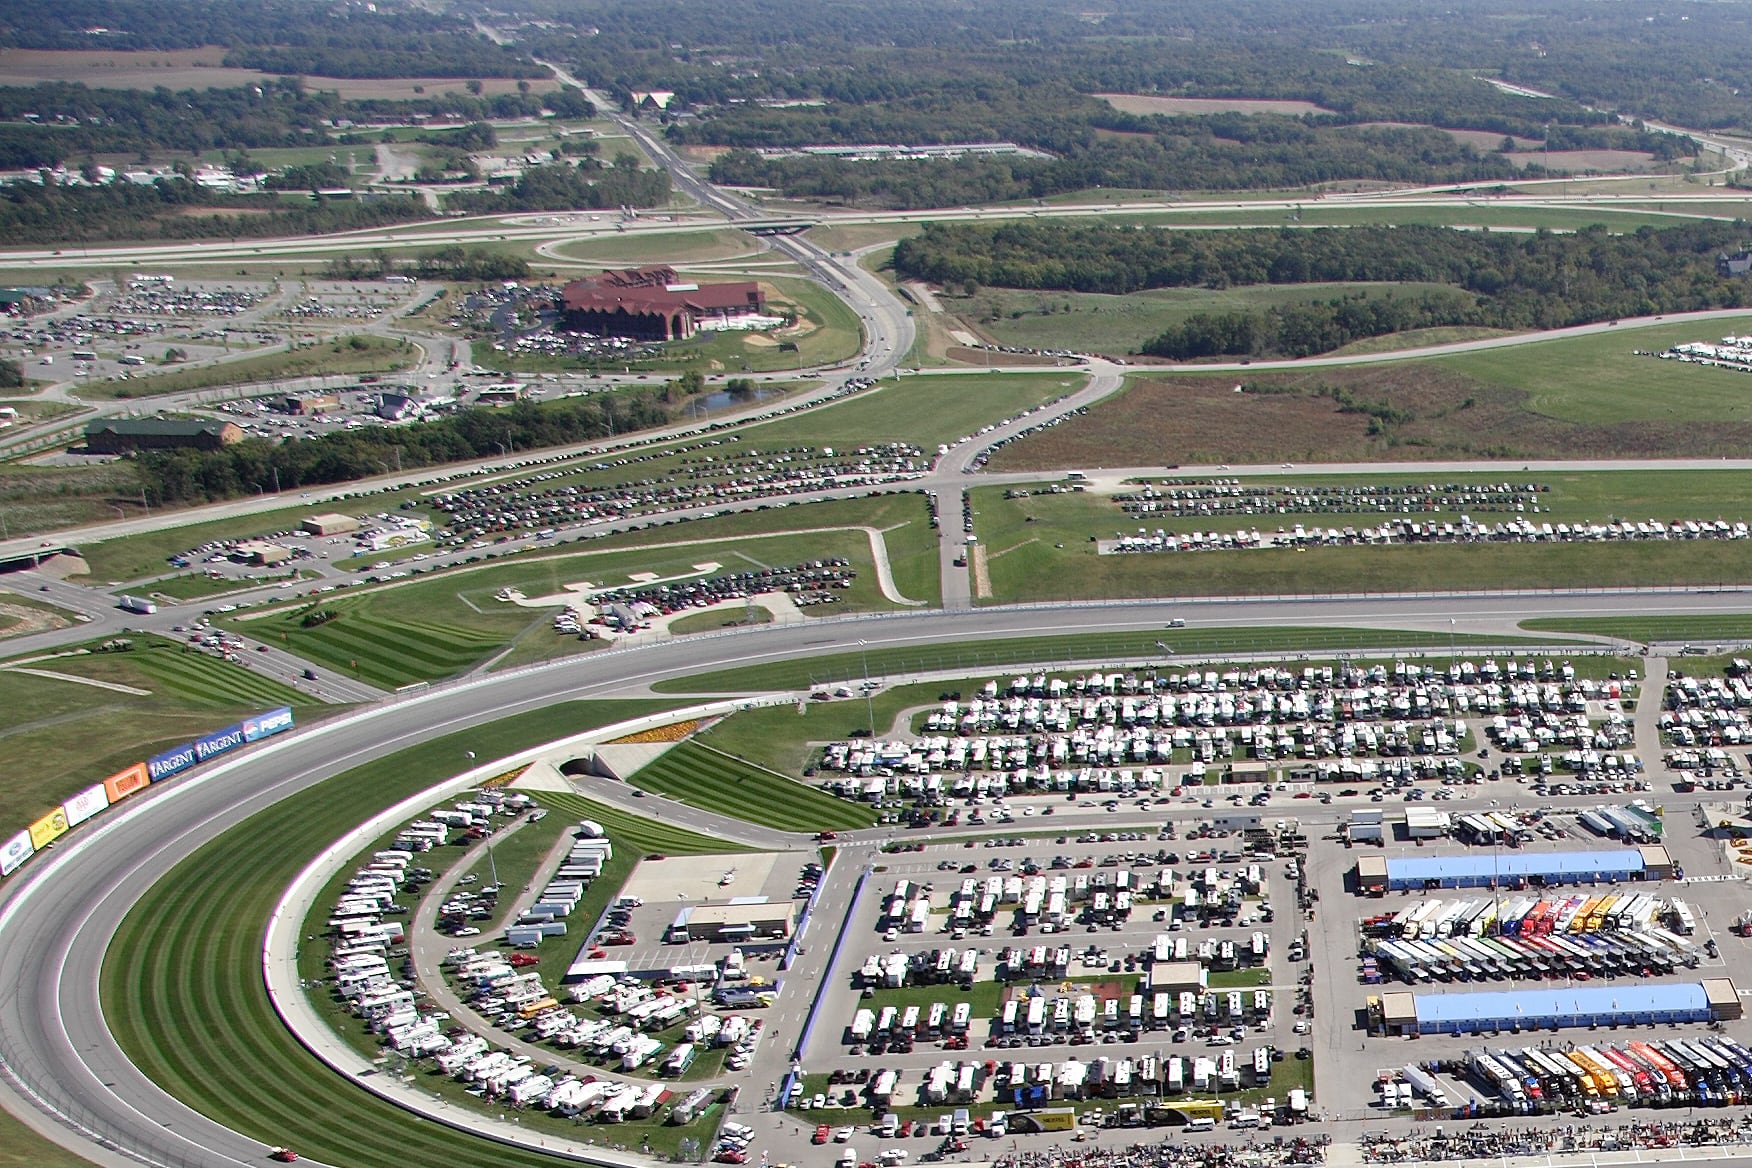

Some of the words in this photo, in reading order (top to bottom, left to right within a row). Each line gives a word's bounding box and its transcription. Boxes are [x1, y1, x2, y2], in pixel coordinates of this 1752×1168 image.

[260, 712, 292, 733] PEPSI
[201, 730, 242, 757] ARGENT
[154, 750, 195, 777] ARGENT
